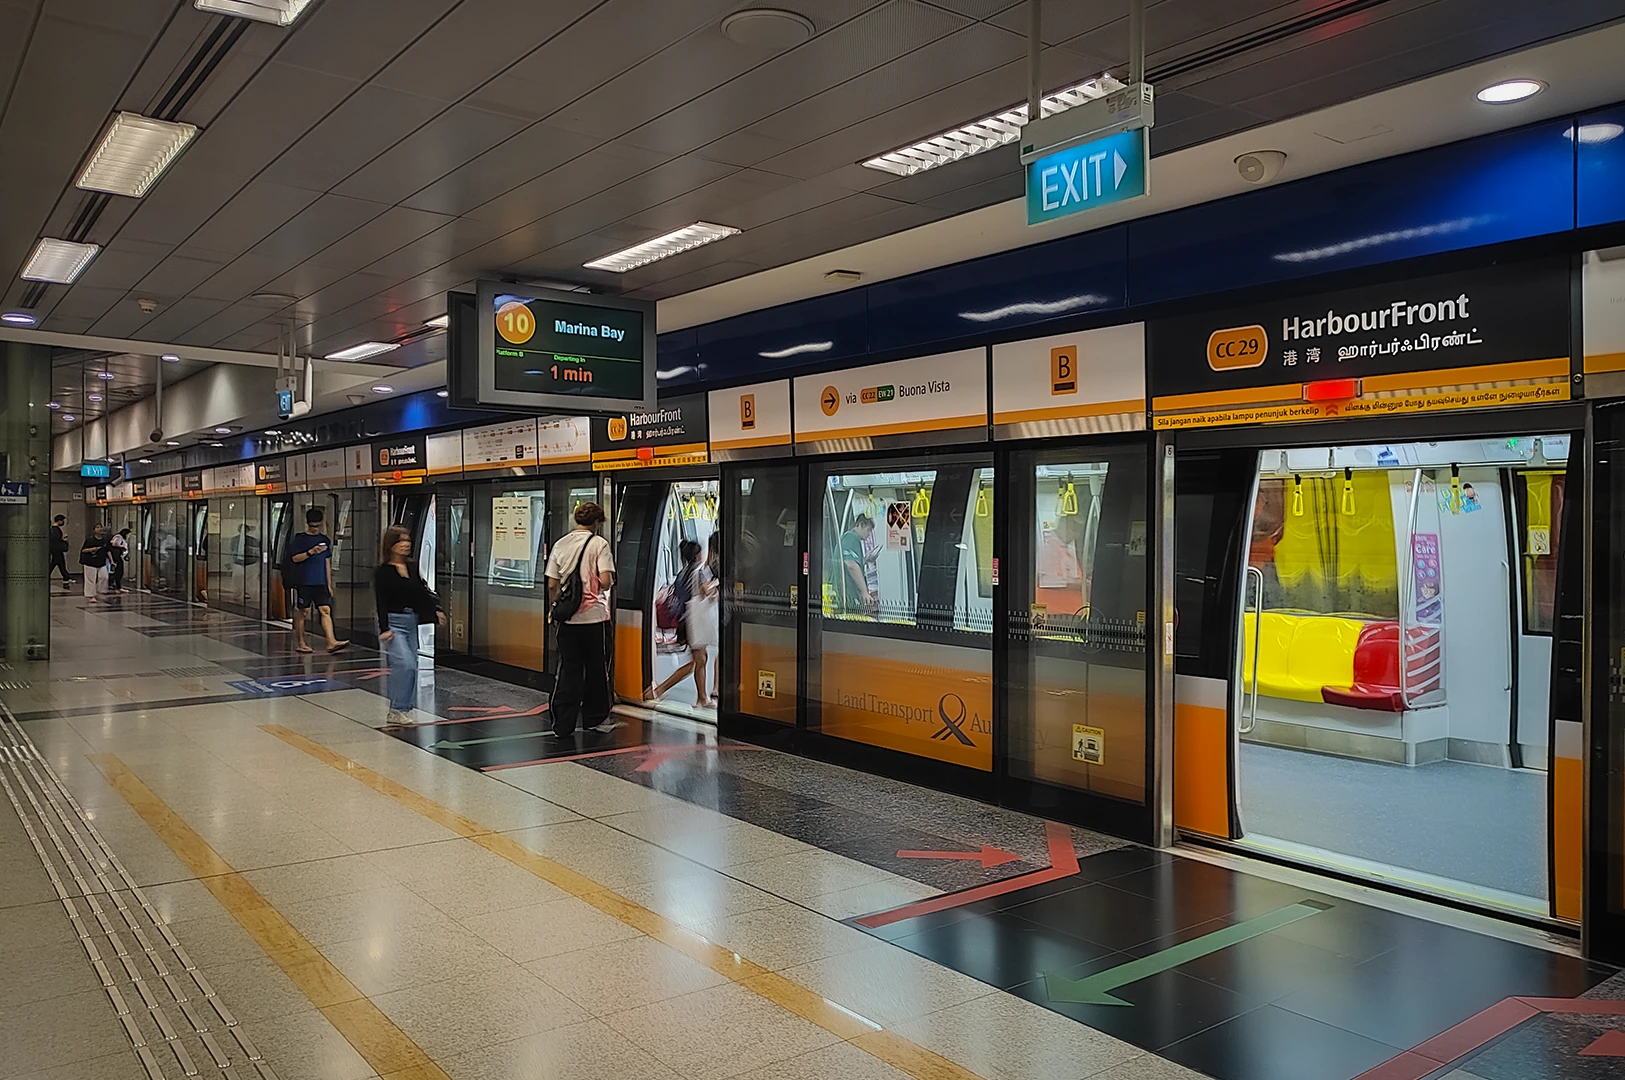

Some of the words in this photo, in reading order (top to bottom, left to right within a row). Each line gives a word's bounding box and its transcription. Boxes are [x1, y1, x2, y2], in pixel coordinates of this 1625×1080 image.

[1041, 150, 1107, 212] EXIT
[503, 312, 529, 334] 10
[1283, 293, 1470, 341] HarbourFront
[554, 319, 598, 338] Marina
[601, 325, 625, 342] Bay
[553, 354, 580, 363] Departing
[1058, 355, 1071, 379] B
[550, 364, 558, 380] 1
[563, 367, 593, 383] min
[846, 392, 857, 404] via
[899, 385, 926, 398] Buona
[928, 380, 950, 394] Vista
[630, 407, 682, 427] HarbourFront
[744, 400, 752, 418] B
[1157, 418, 1169, 426] Sila
[1169, 418, 1191, 427] jangan
[1192, 415, 1206, 423] naik
[1207, 414, 1231, 424] apabila
[1232, 412, 1254, 421] lampu
[1255, 409, 1288, 420] penunjuk
[1289, 406, 1320, 417] berkelip
[1415, 543, 1436, 554] Care
[836, 688, 866, 711] Land
[868, 693, 934, 724] Transport
